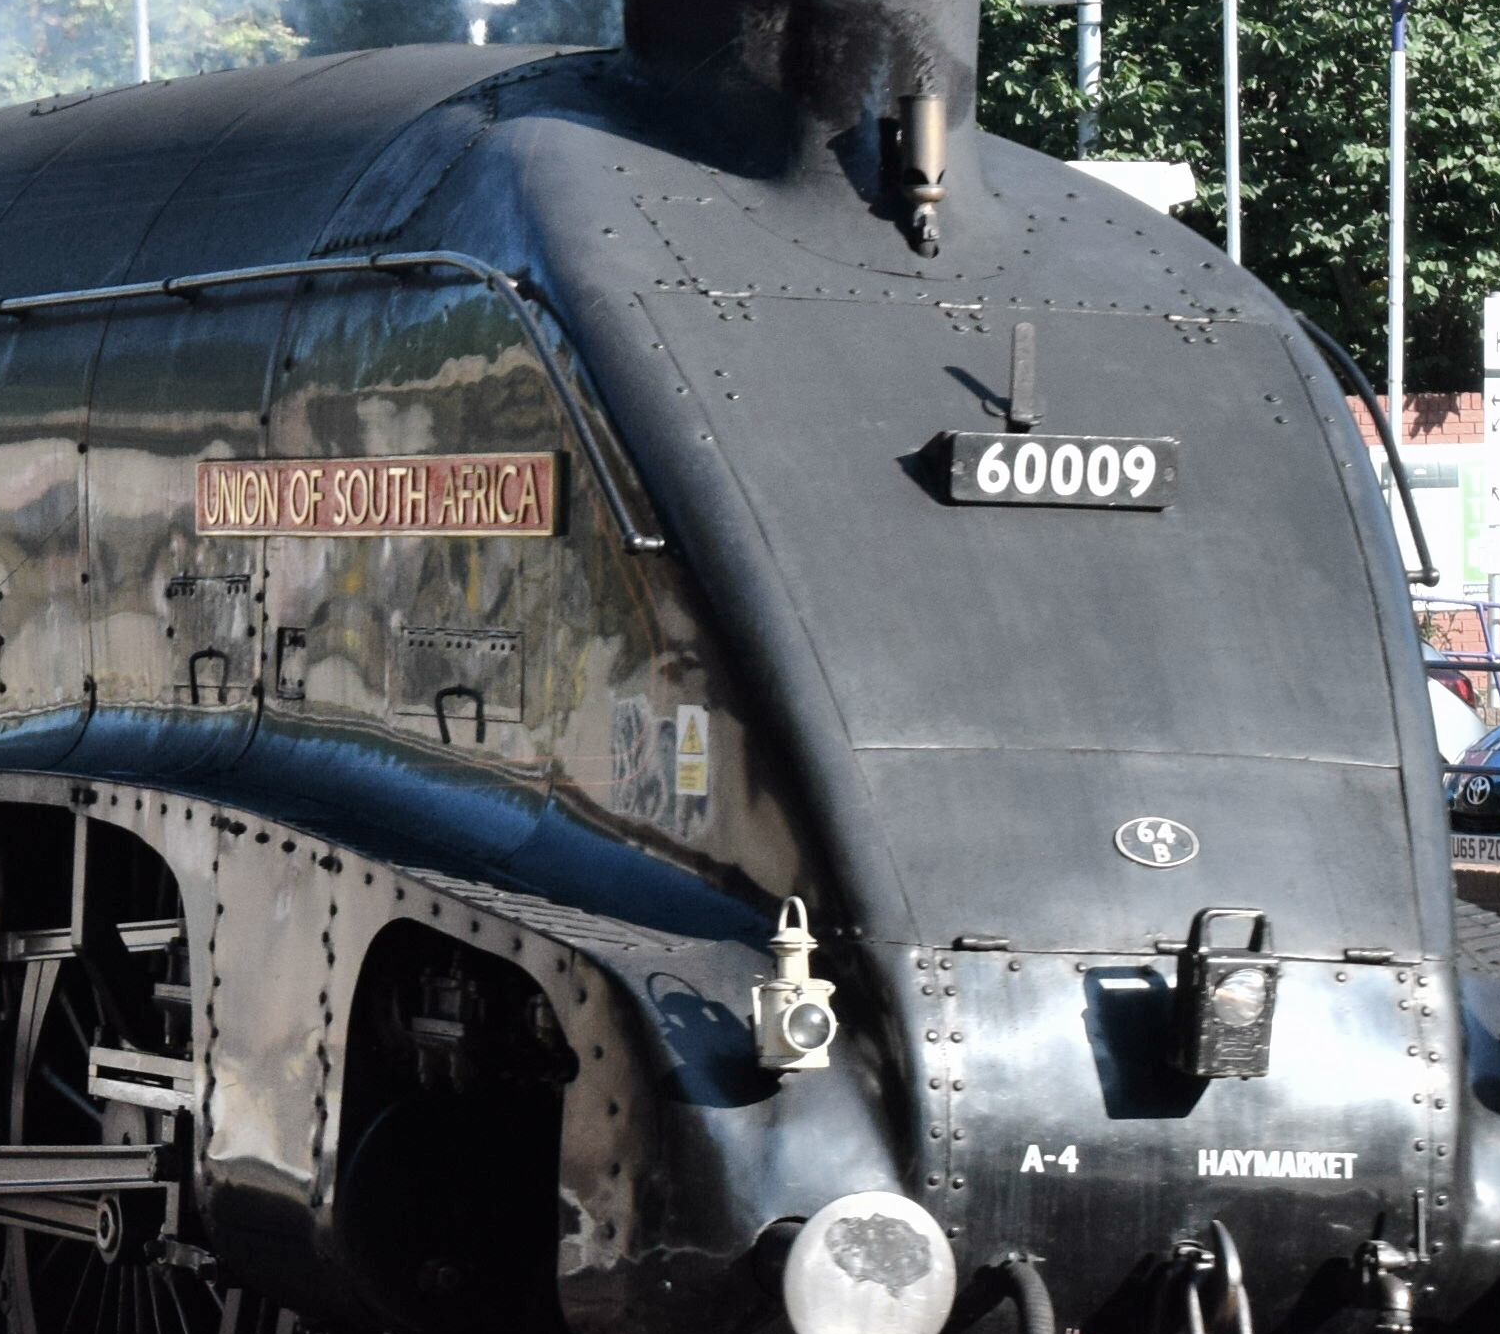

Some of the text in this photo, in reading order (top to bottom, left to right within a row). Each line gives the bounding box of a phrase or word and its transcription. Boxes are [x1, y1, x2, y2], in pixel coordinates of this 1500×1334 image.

[976, 441, 1157, 499] 60009
[203, 463, 543, 527] UNION OF SOUTH AFRICA
[1136, 820, 1177, 844] 64
[1152, 843, 1172, 863] B
[1019, 1143, 1080, 1174] A-4
[1197, 1148, 1359, 1180] HAYMARKET
